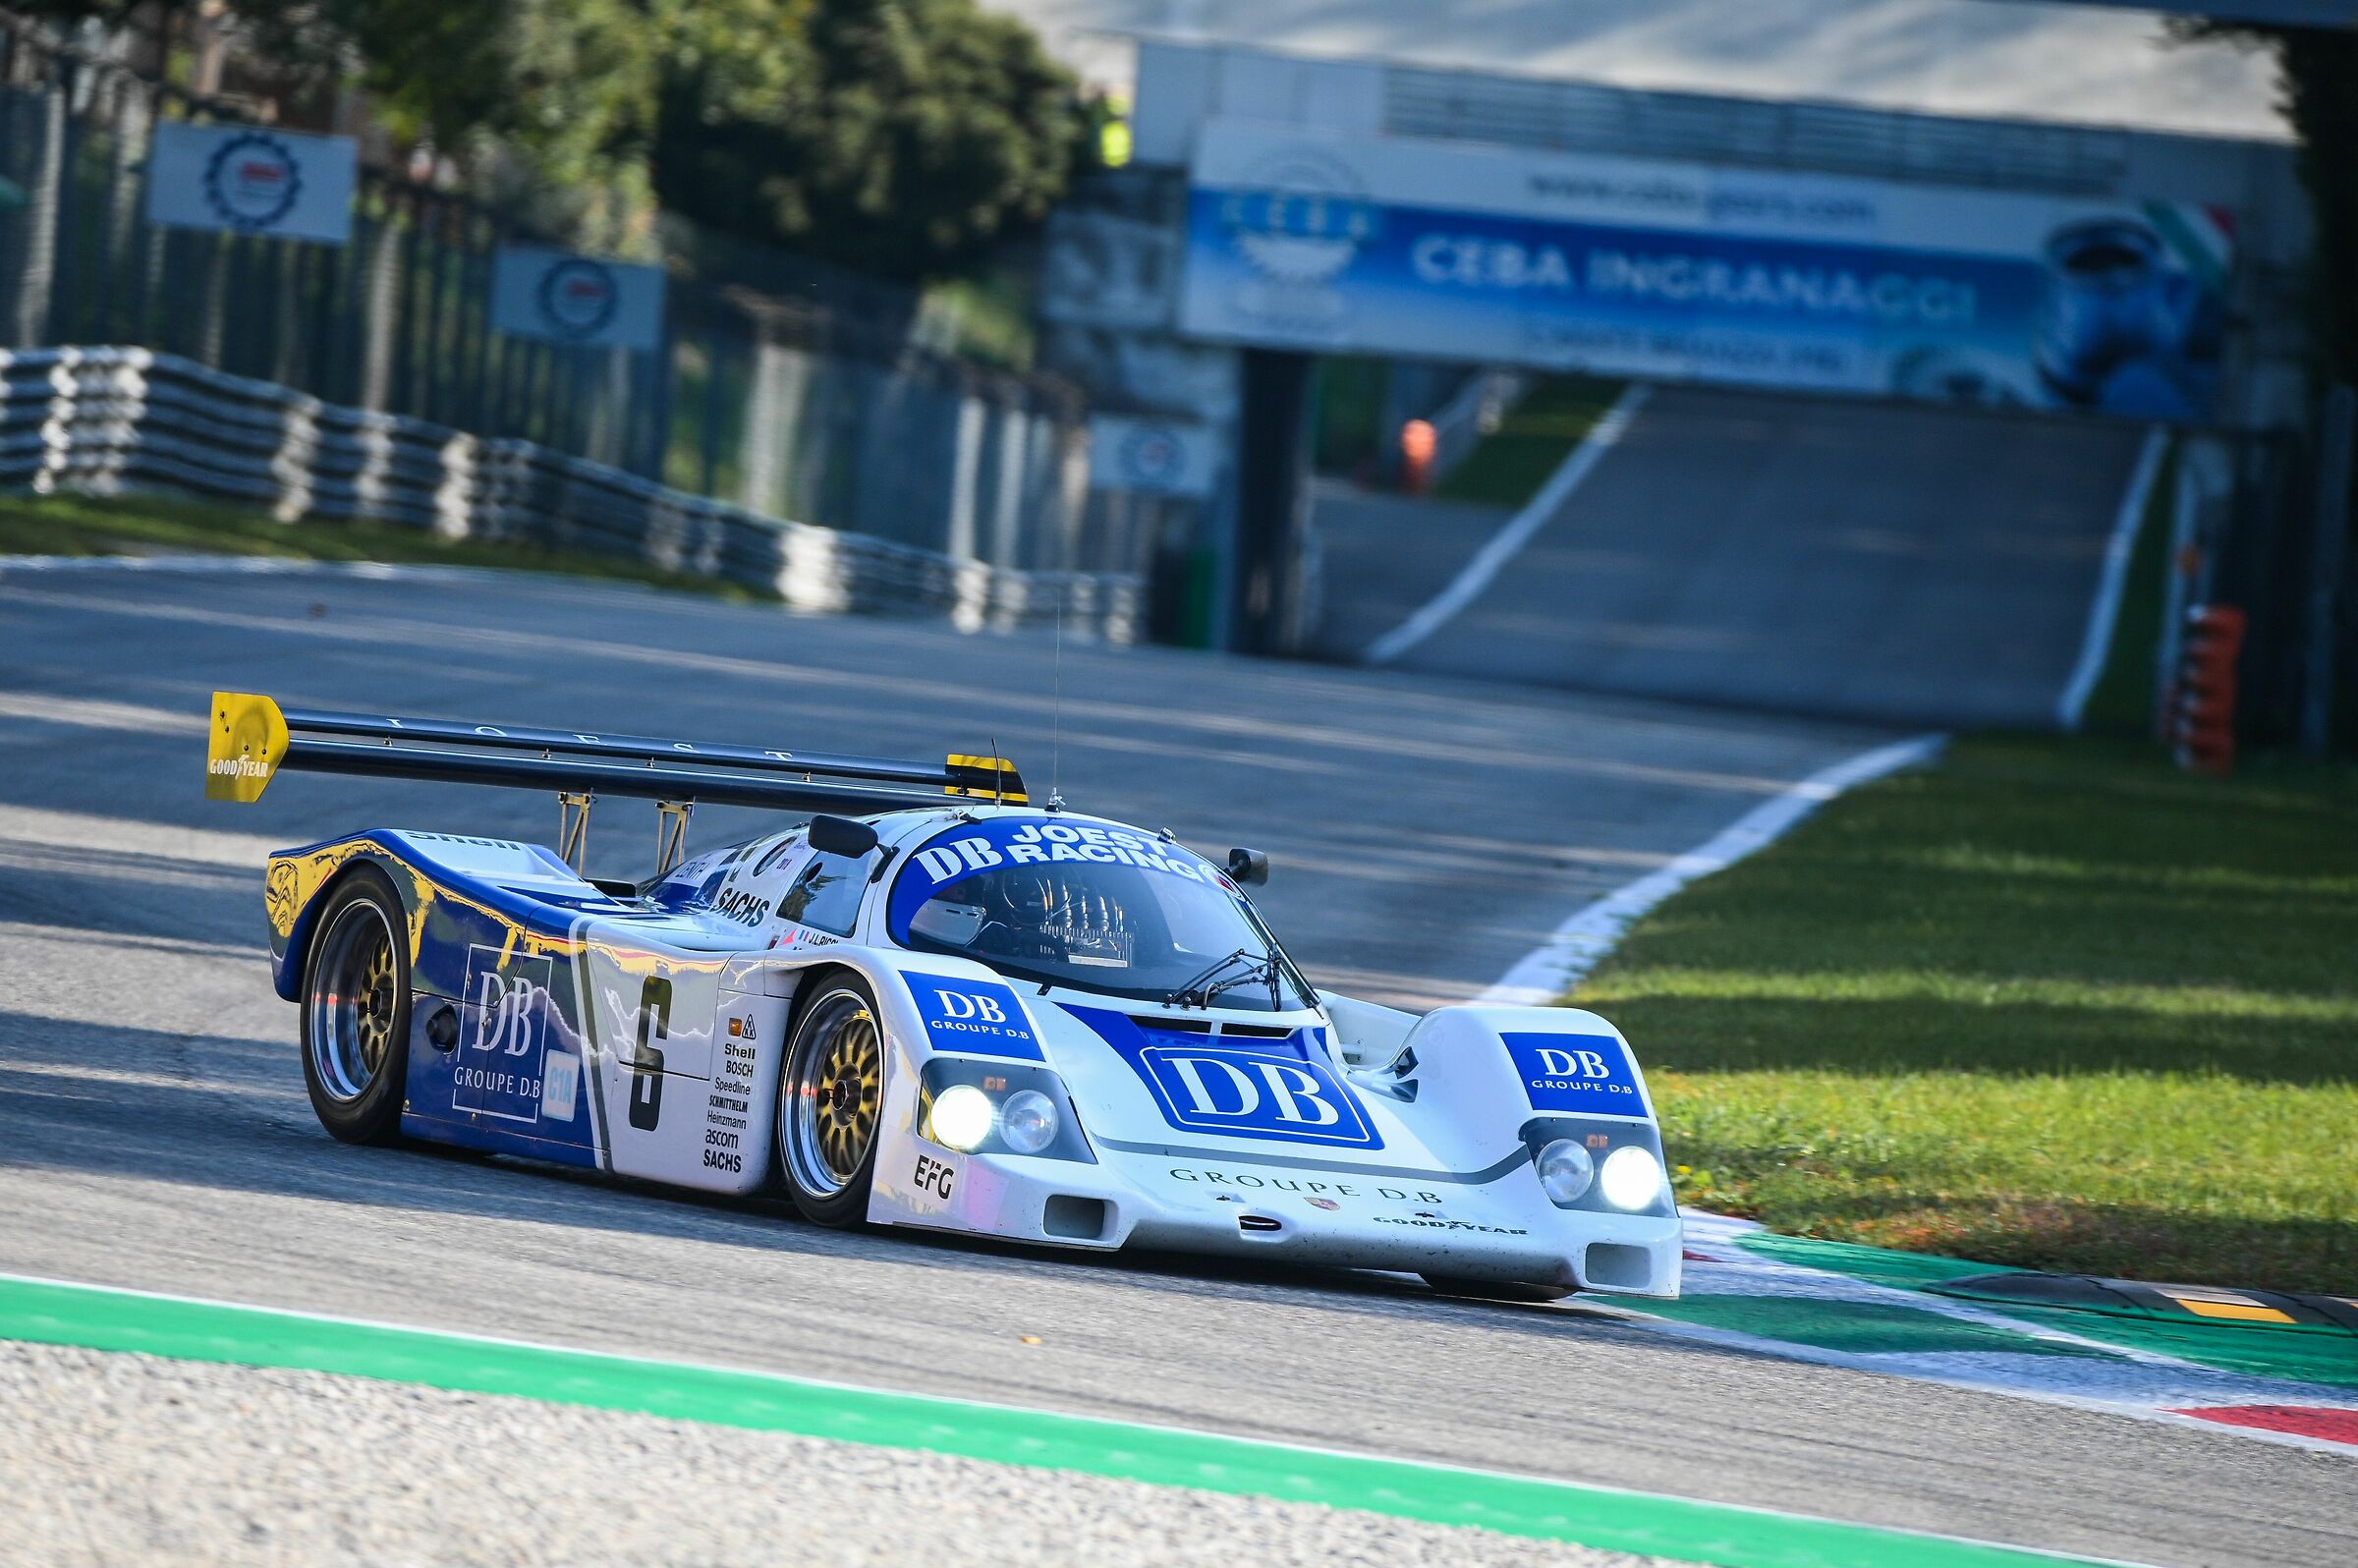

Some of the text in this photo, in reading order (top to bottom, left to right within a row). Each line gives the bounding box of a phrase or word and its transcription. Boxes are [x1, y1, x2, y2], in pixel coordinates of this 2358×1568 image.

[1412, 233, 1978, 324] CEBA INGRANAGGI
[1012, 824, 1169, 856] JOEST
[913, 837, 1003, 885] DB
[1007, 843, 1206, 883] RACING
[709, 887, 770, 927] SACHS
[472, 971, 534, 1057] DB
[933, 988, 1007, 1024] DB
[930, 1020, 1030, 1040] GROUPE D.B
[629, 975, 673, 1132] 6
[724, 1042, 756, 1060] Shell
[1535, 1048, 1610, 1079] DB
[454, 1066, 540, 1098] GROUPE D.B
[725, 1060, 755, 1078] BOSCH
[714, 1076, 751, 1095] Speedline
[1160, 1056, 1340, 1126] DB
[1531, 1080, 1633, 1094] GROUPE D.B
[706, 1109, 747, 1130] Heinzmann
[708, 1094, 749, 1113] SCHMITTHELM
[705, 1129, 739, 1149] ascom
[702, 1148, 742, 1173] SACHS
[914, 1154, 955, 1200] EFG
[1169, 1168, 1442, 1204] GROUPE D.B
